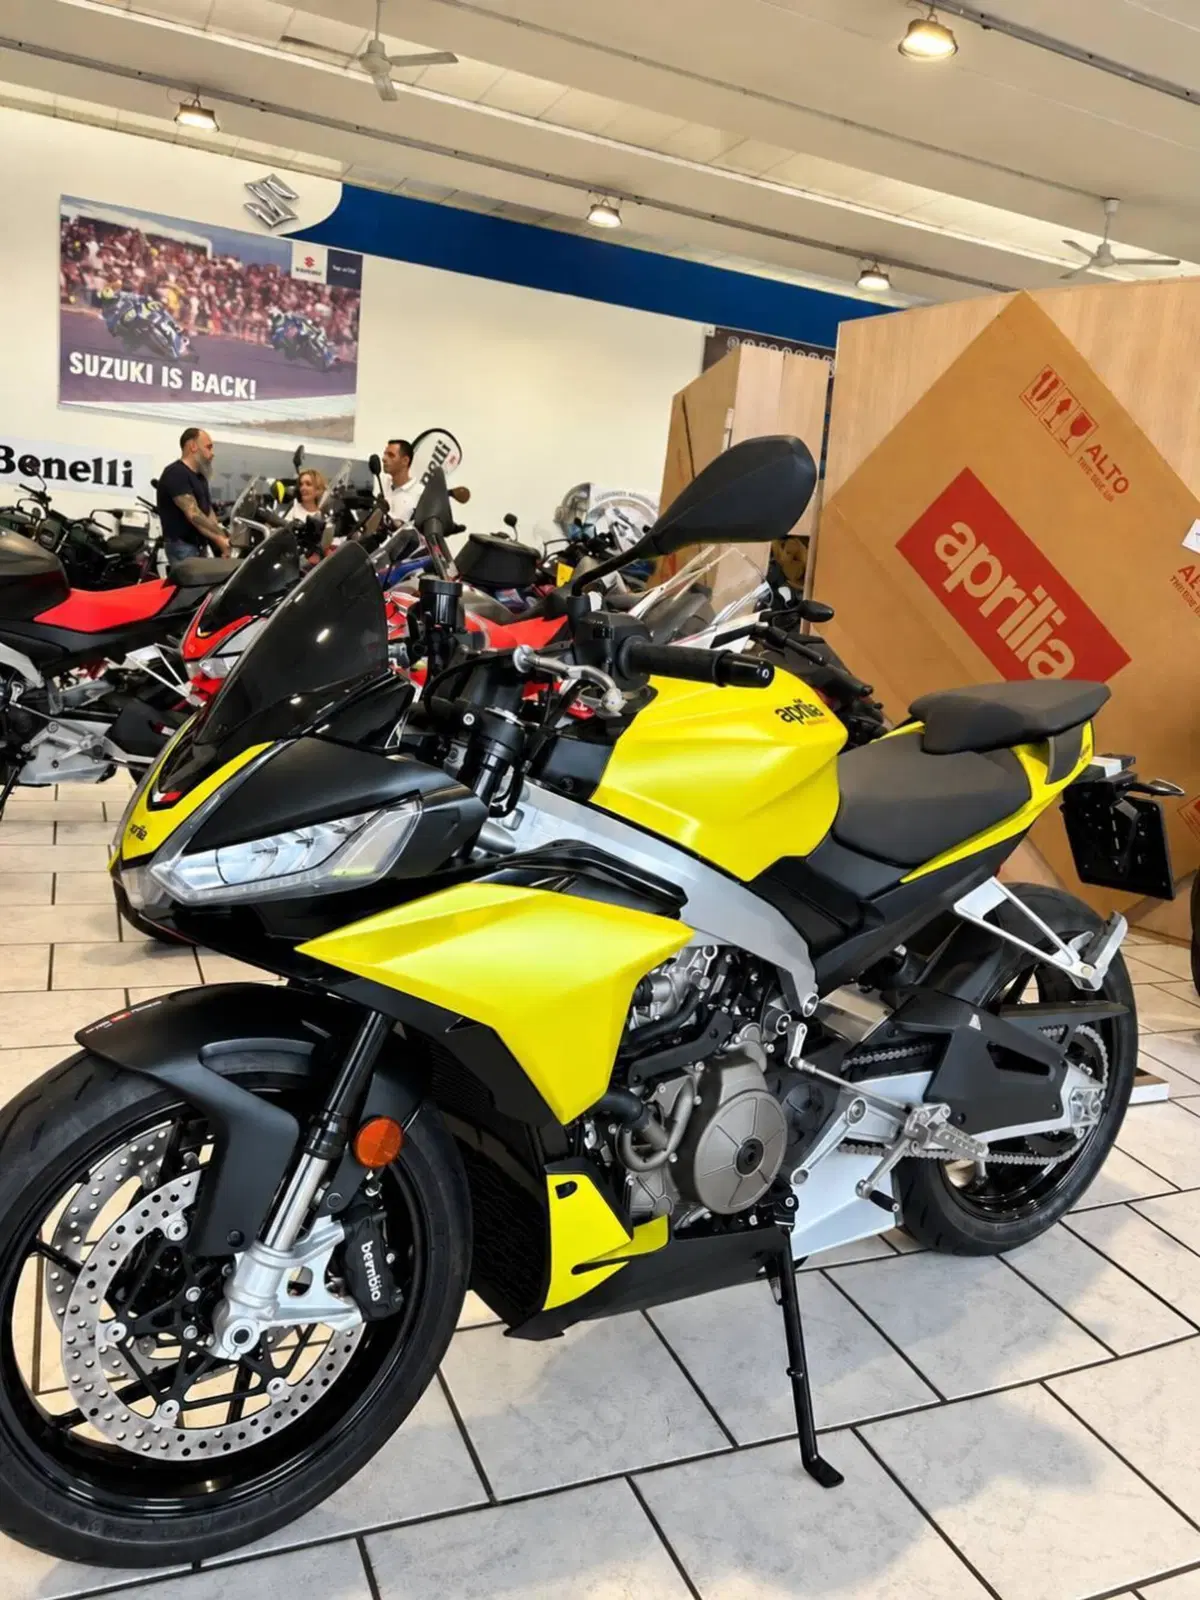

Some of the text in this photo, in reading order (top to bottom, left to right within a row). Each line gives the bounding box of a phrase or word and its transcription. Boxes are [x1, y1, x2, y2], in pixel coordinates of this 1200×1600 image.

[69, 352, 256, 400] SUZUKI IS BACK!
[0, 445, 133, 488] Benelli
[1085, 444, 1129, 494] ALTO
[935, 521, 1076, 681] aprilia
